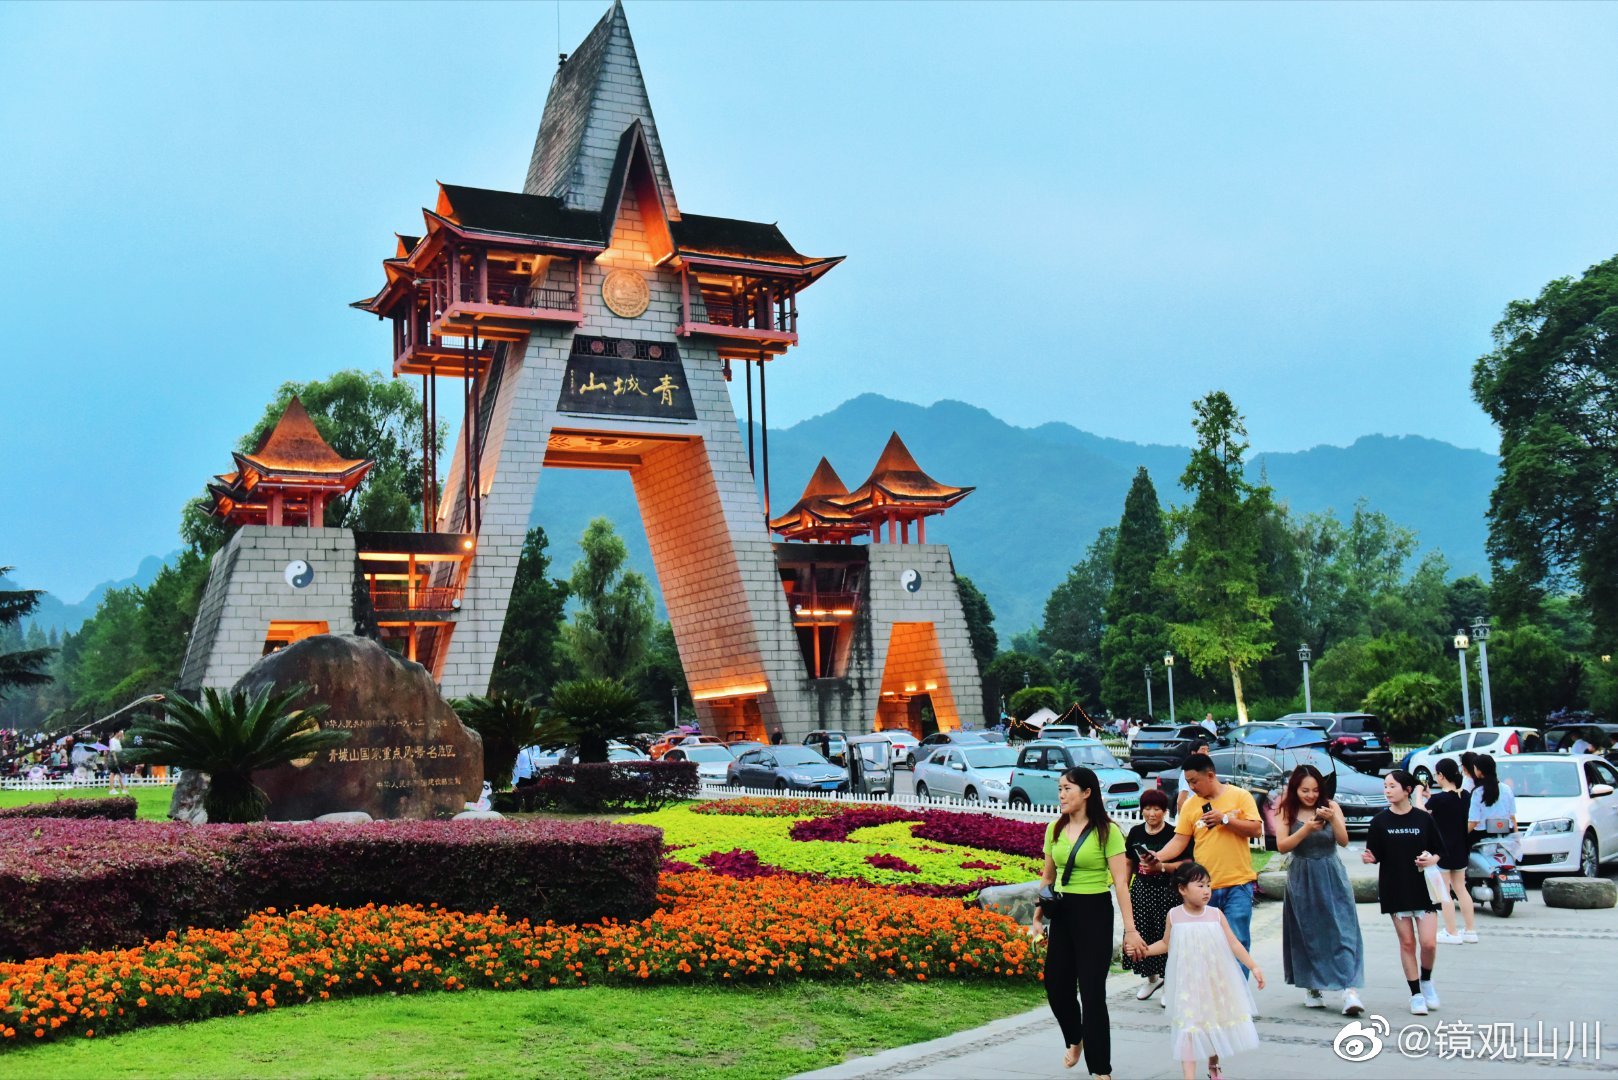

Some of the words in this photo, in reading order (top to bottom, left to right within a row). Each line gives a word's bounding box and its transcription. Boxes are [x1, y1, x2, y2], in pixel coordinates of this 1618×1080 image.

[579, 371, 679, 406] 青城山
[1387, 828, 1420, 836] wassup
